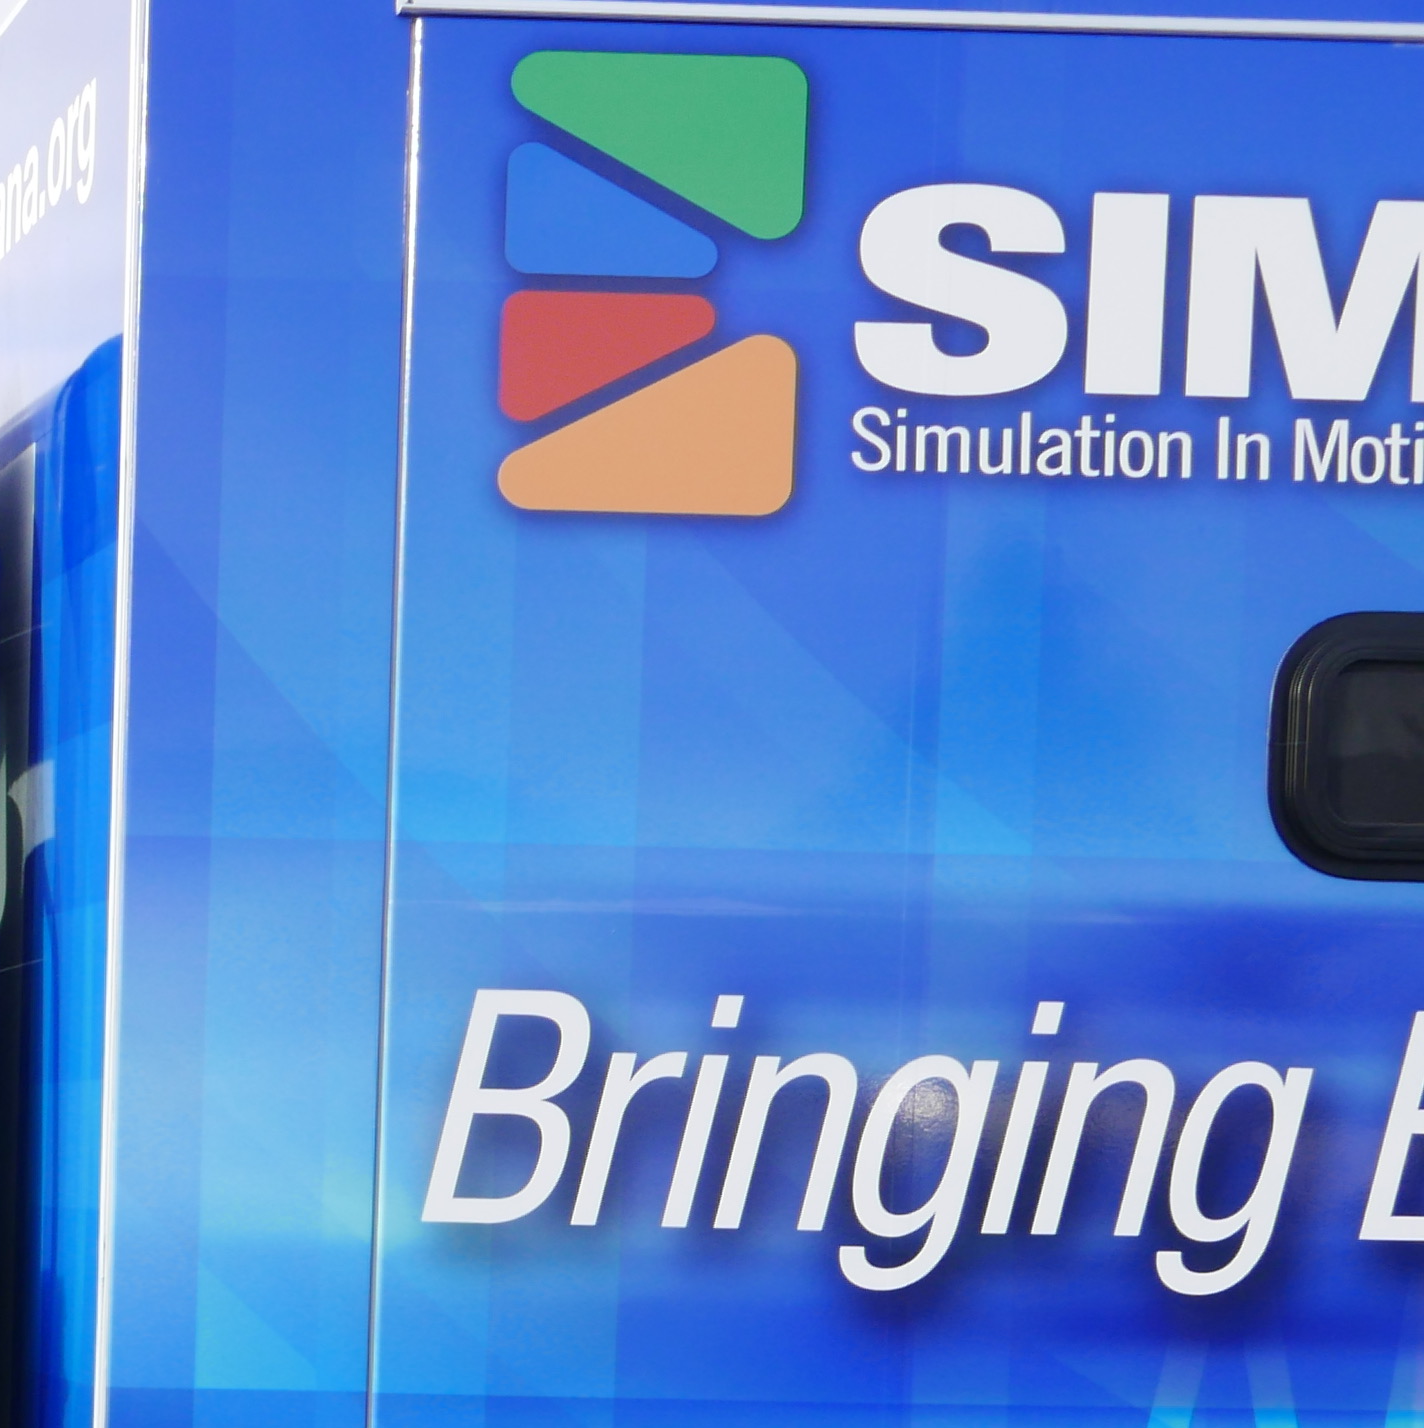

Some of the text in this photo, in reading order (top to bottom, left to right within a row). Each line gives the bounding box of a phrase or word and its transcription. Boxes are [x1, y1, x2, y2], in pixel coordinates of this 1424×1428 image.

[850, 406, 1193, 478] Simulation
[1217, 415, 1271, 481] In
[420, 987, 1314, 1296] Bringing
